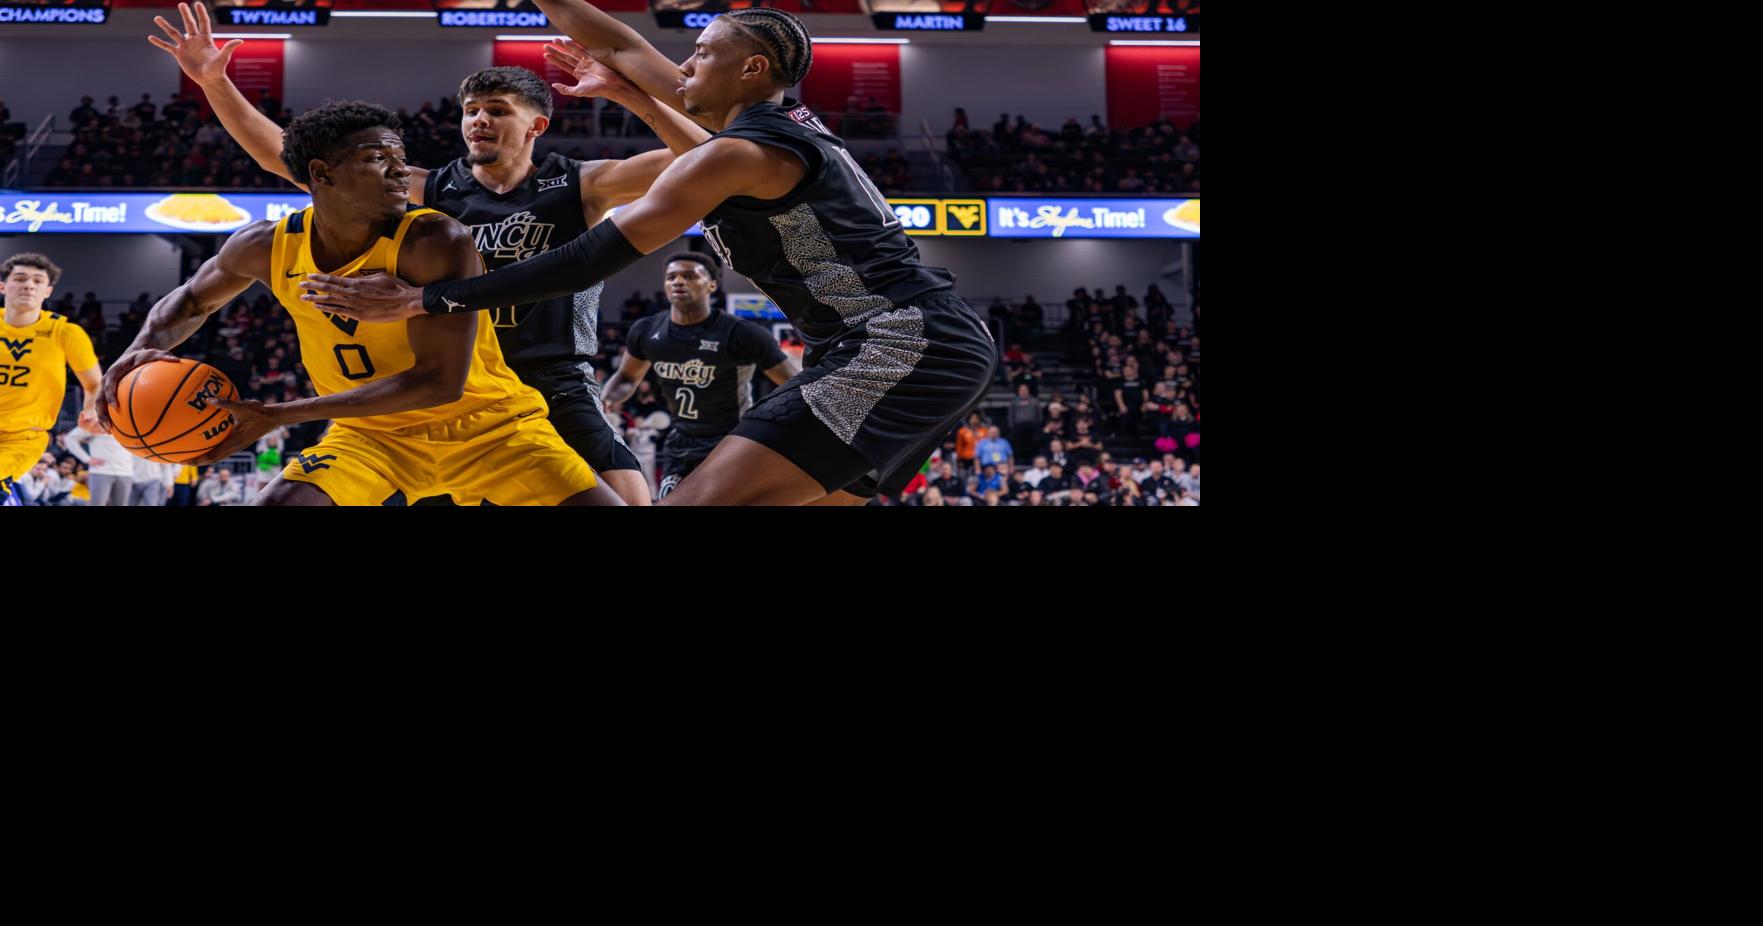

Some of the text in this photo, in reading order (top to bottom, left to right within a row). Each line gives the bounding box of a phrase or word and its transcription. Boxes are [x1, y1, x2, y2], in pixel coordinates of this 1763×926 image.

[0, 8, 105, 22] CHAMPIONS
[230, 10, 316, 24] TWYMAN
[441, 12, 546, 26] ROBERTSON
[895, 15, 964, 29] MARTIN
[1106, 17, 1187, 32] SWEET 16
[72, 202, 127, 223] Time!
[895, 206, 930, 228] 20
[999, 207, 1030, 228] It's
[1092, 207, 1146, 228] Time!
[333, 344, 376, 380] 0
[675, 387, 699, 420] 2
